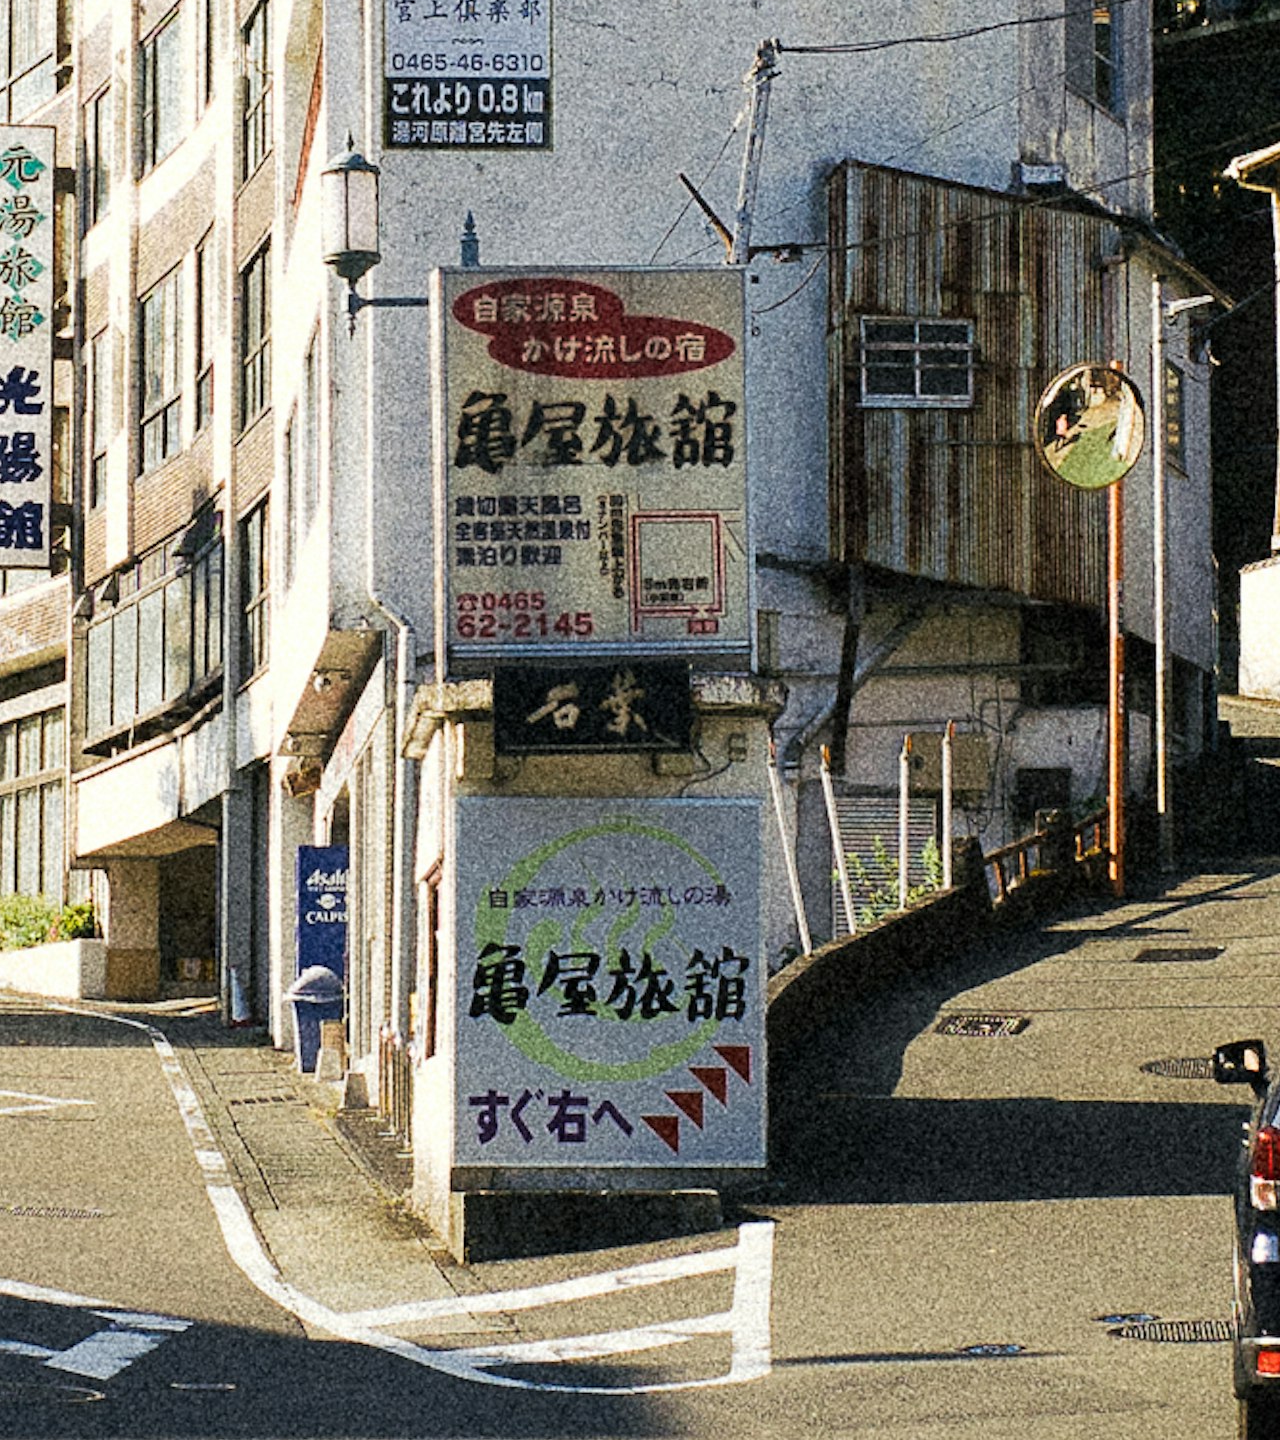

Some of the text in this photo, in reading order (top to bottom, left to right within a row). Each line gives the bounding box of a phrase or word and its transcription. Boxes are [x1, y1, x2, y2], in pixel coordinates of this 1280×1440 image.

[392, 52, 543, 72] 0465-46-6310
[391, 82, 471, 115] これより
[473, 292, 599, 323] 自家源泉
[521, 332, 707, 364] かけ流しの宿
[481, 591, 545, 611] 0465
[458, 611, 595, 638] 62-2145
[468, 1089, 635, 1146] すぐ右へ
